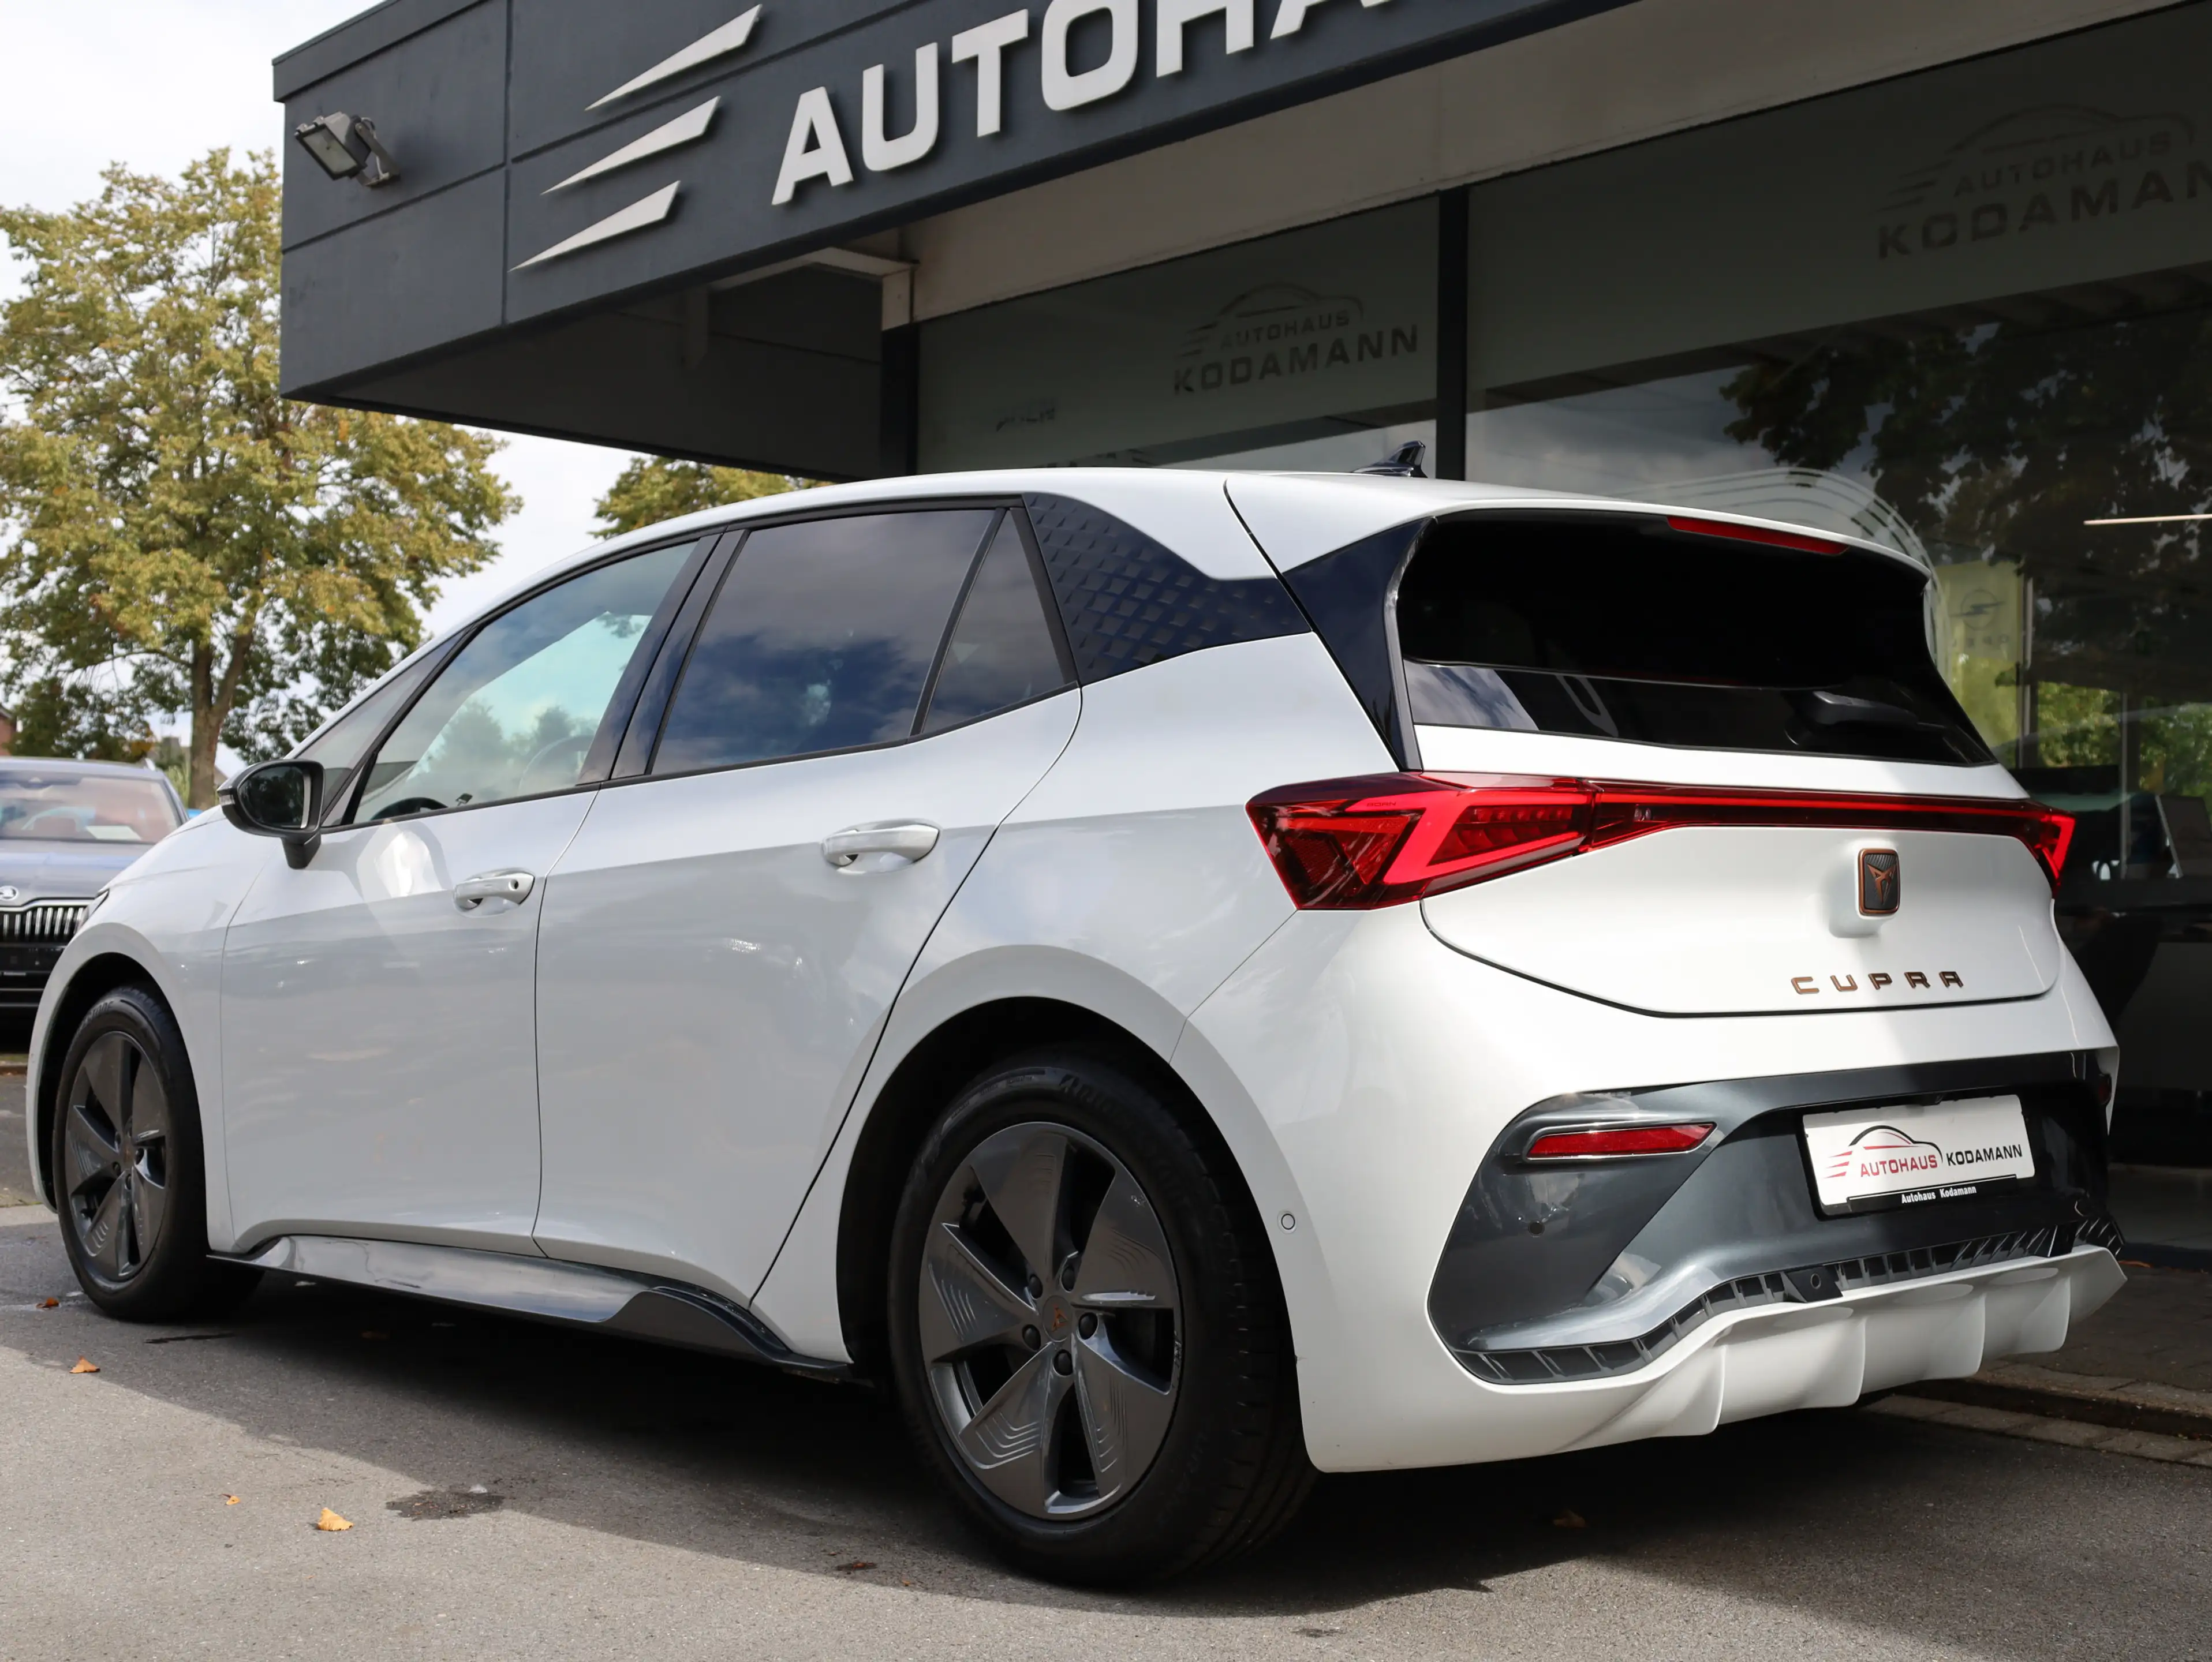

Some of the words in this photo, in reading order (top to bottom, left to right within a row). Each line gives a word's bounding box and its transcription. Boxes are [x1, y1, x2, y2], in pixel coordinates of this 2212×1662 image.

[1953, 131, 2172, 197] AUTOHAUS
[1220, 309, 1350, 350] AUTOHAUS
[1174, 324, 1418, 395] KODAMANN
[1791, 971, 1964, 994] CUPRA
[1860, 1154, 1938, 1178] AUTOHAUS
[1946, 1144, 2023, 1166] KODAMANN
[1901, 1192, 1937, 1204] Autohaus
[1939, 1186, 1977, 1199] Kodamann
